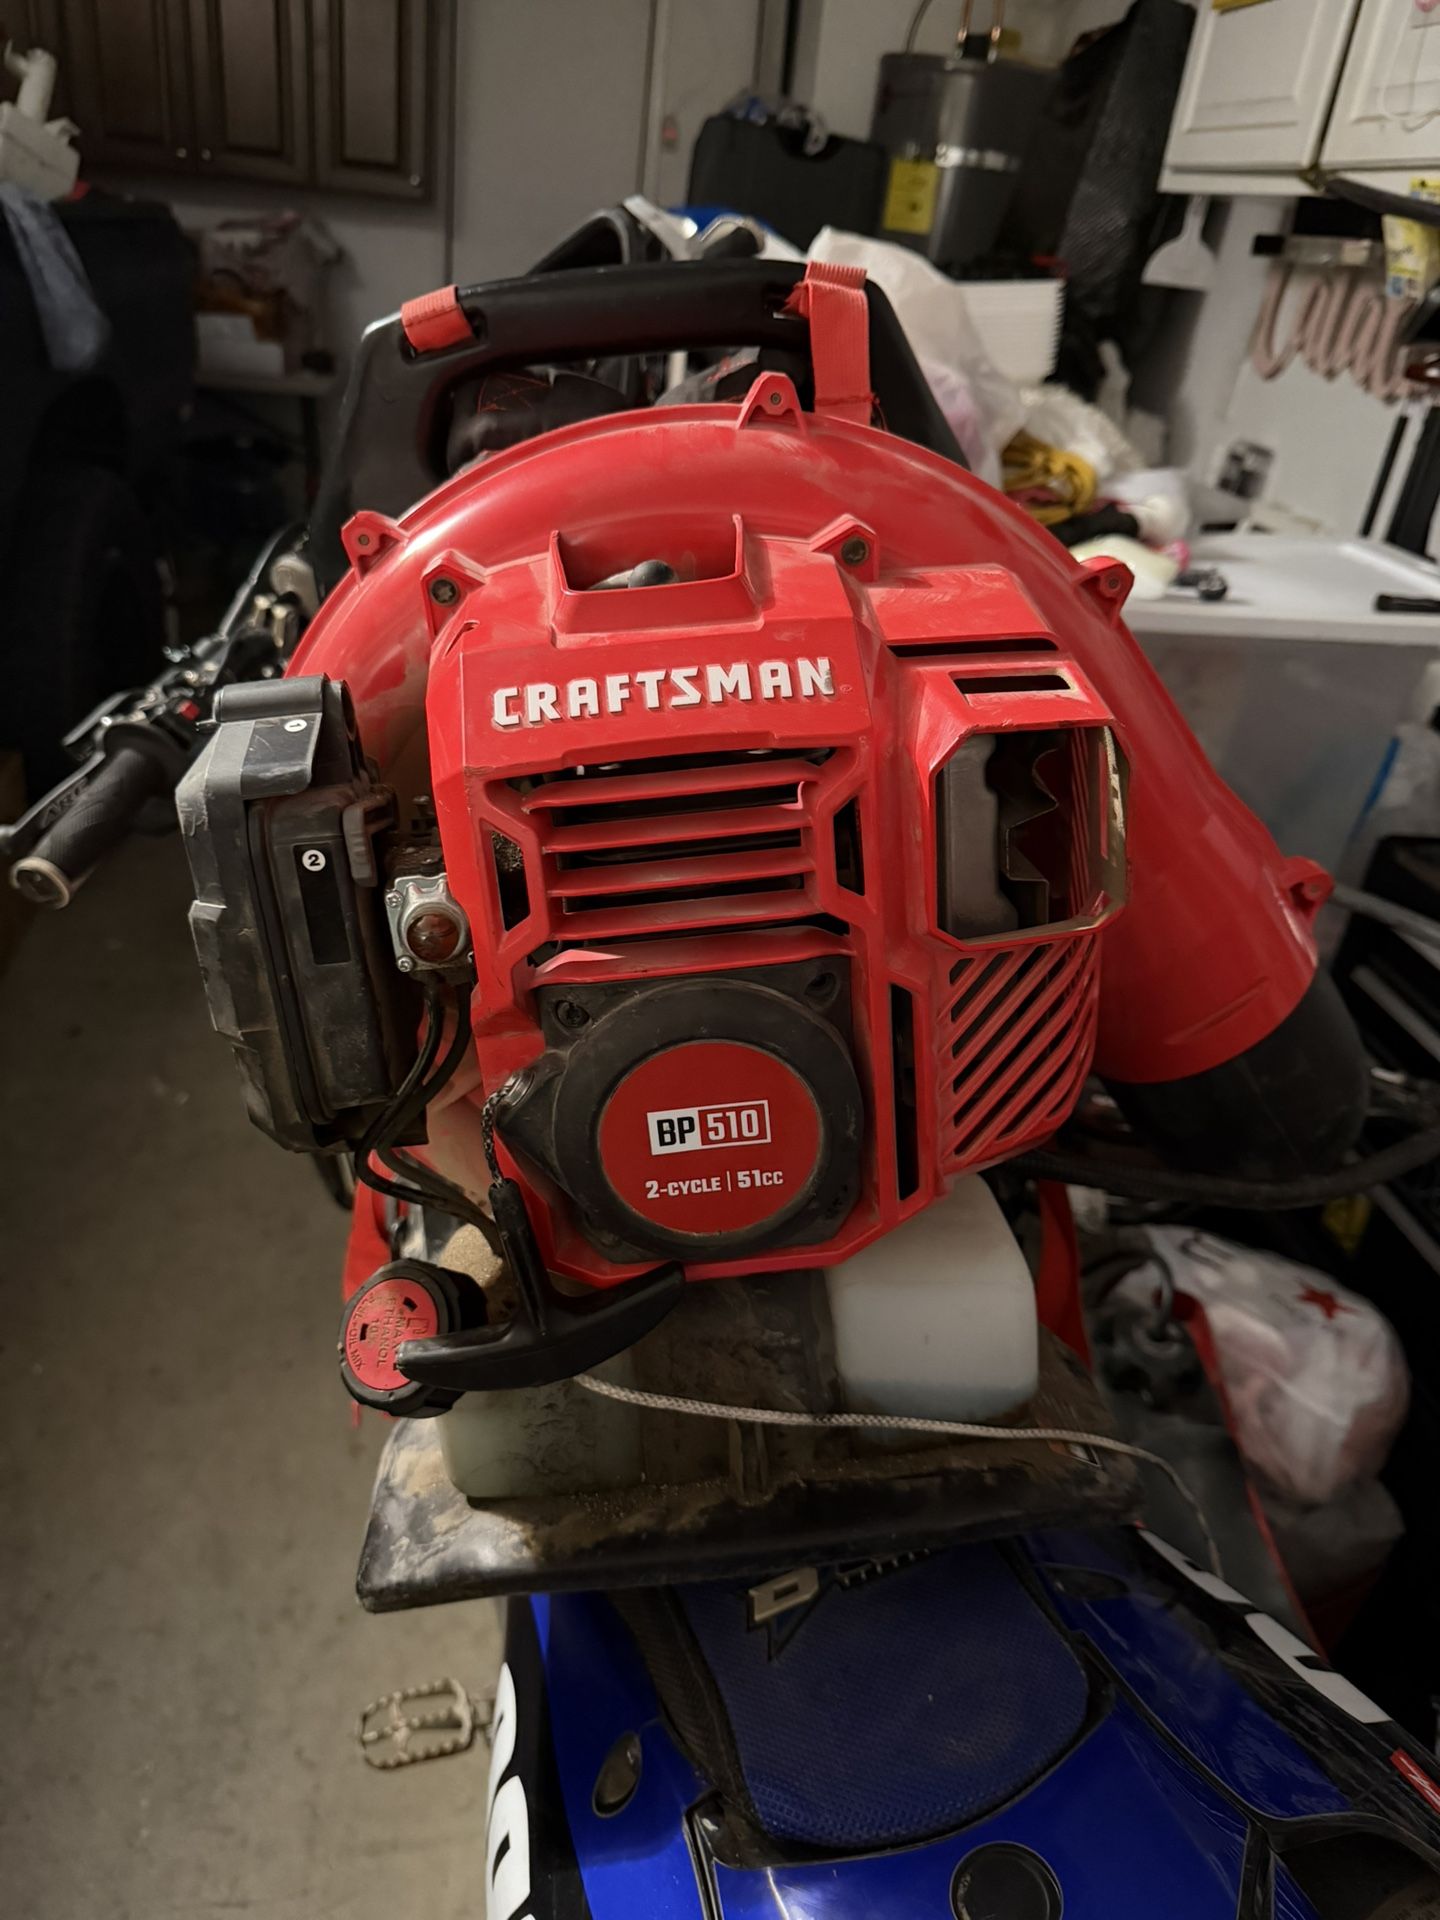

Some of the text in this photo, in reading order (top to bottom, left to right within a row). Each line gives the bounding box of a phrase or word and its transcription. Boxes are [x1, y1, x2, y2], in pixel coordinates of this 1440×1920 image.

[493, 657, 835, 728] CRAFTSMAN
[308, 854, 321, 867] 2
[656, 1109, 760, 1147] BP 510
[645, 1176, 722, 1199] 2-CYCLE
